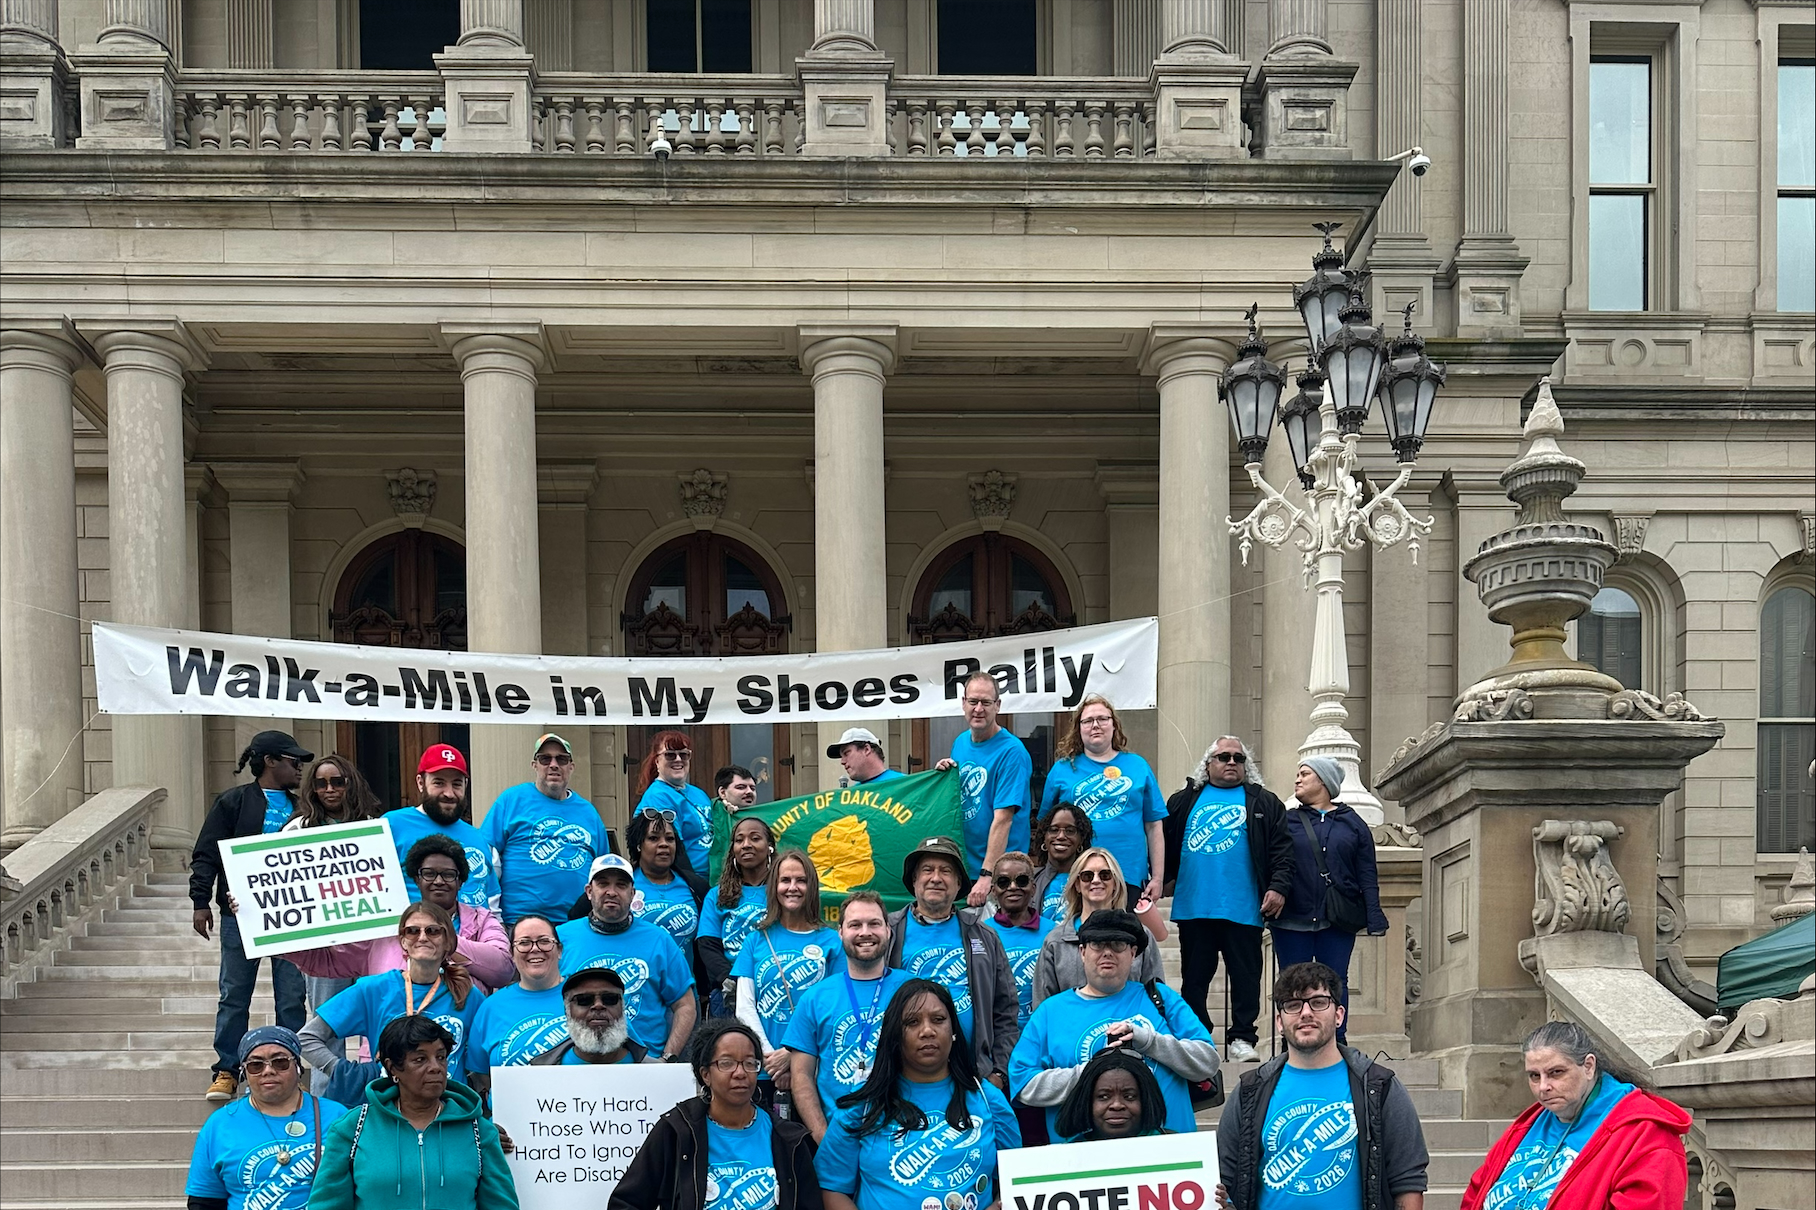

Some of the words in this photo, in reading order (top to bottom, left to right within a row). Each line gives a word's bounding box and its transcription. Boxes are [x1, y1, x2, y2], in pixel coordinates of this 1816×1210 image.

[166, 646, 531, 714] Walk-a-Mile
[549, 675, 606, 716] in
[627, 677, 715, 723] My
[736, 673, 920, 715] Shoes
[944, 646, 1094, 707] Rally
[770, 800, 809, 842] OUNTY
[815, 792, 834, 810] OF
[841, 790, 913, 825] OAKLAND
[1190, 809, 1239, 847] WALK-A-MILE
[264, 849, 315, 868] CUTS
[319, 843, 360, 861] AND
[1216, 838, 1234, 852] 2026
[247, 856, 385, 889] PRIVATIZATION
[253, 885, 315, 909] WILL
[318, 874, 389, 900] HURT,
[263, 906, 316, 931] NOT
[322, 896, 392, 921] HEAL.
[824, 906, 840, 922] 18
[921, 947, 946, 960] COUNTY
[519, 1017, 546, 1031] COUNTY
[1080, 1036, 1095, 1062] AKLAND
[536, 1098, 567, 1113] We
[573, 1098, 597, 1115] Try
[603, 1096, 653, 1112] Hard.
[529, 1122, 583, 1137] Those
[589, 1120, 632, 1135] Who
[637, 1119, 655, 1134] Tr
[1267, 1115, 1286, 1152] OAKLAND
[1285, 1103, 1318, 1119] COUNTY
[515, 1145, 560, 1161] Hard
[567, 1144, 586, 1159] To
[593, 1144, 640, 1162] Ignor
[1267, 1110, 1350, 1181] WALK-A-MILE
[534, 1168, 567, 1183] Are
[574, 1166, 629, 1182] Disab
[713, 1166, 744, 1178] COUNTY
[947, 1163, 974, 1187] 2026
[1314, 1164, 1345, 1192] 2026
